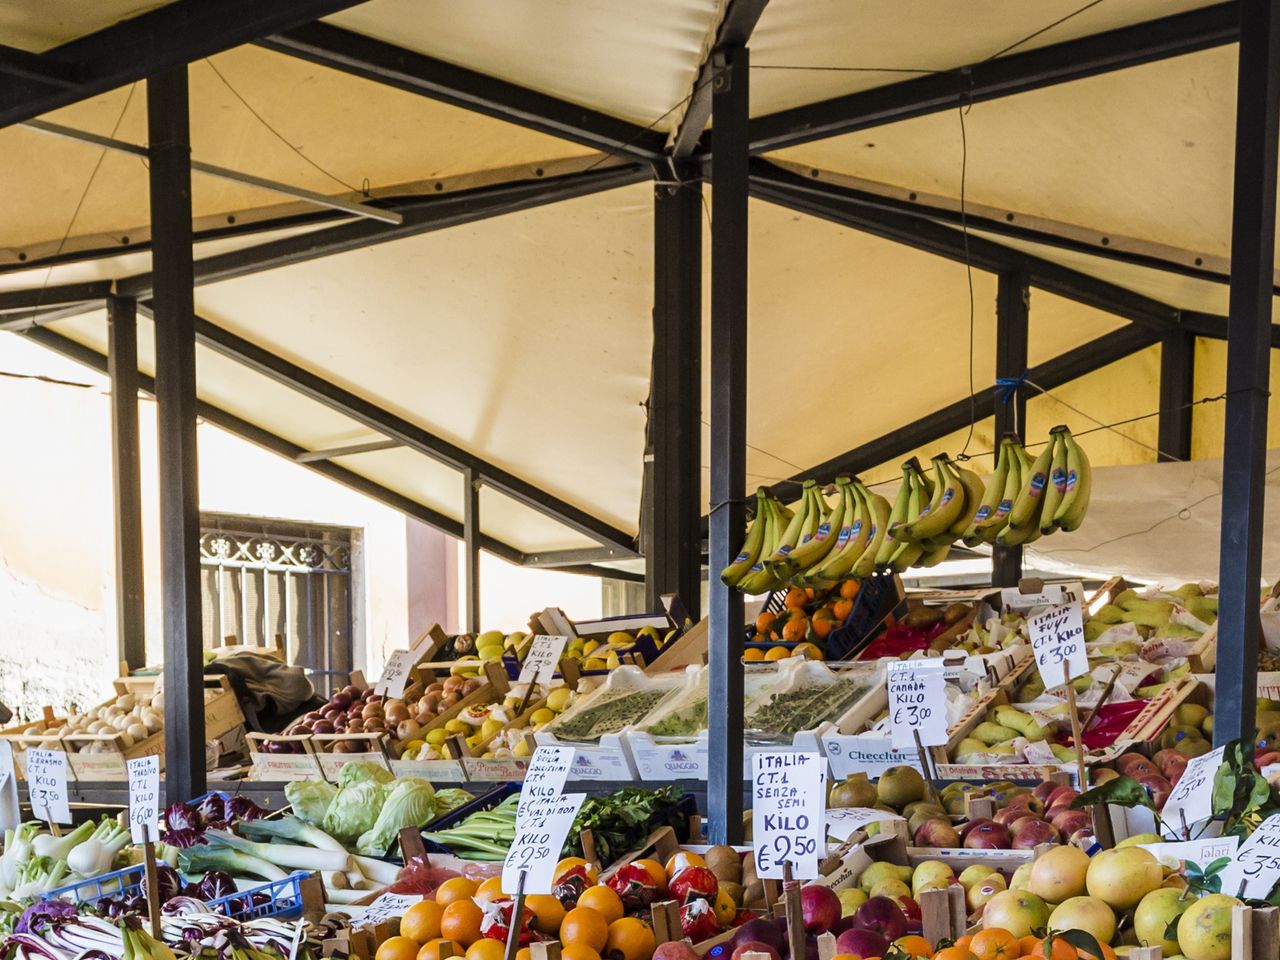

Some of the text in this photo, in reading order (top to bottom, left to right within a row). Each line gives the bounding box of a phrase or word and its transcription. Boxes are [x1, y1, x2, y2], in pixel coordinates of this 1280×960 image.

[1034, 606, 1072, 625] ITALIA
[1056, 627, 1082, 644] KILO
[531, 650, 553, 658] KILO
[890, 683, 927, 693] CANADA
[896, 693, 925, 704] KILO
[535, 747, 561, 755] ITALIA
[848, 749, 907, 761] Checchin
[129, 759, 152, 770] ITALIA
[664, 762, 699, 771] QUAGGIO
[758, 753, 810, 769] ITALIA
[133, 767, 157, 778] TARDIVO
[35, 775, 57, 787] KILO
[135, 792, 154, 802] KILO
[528, 786, 554, 797] KILO
[536, 795, 568, 805] ITALIA
[777, 798, 806, 810] SEMI
[763, 812, 810, 831] KILO
[517, 833, 550, 846] KILO
